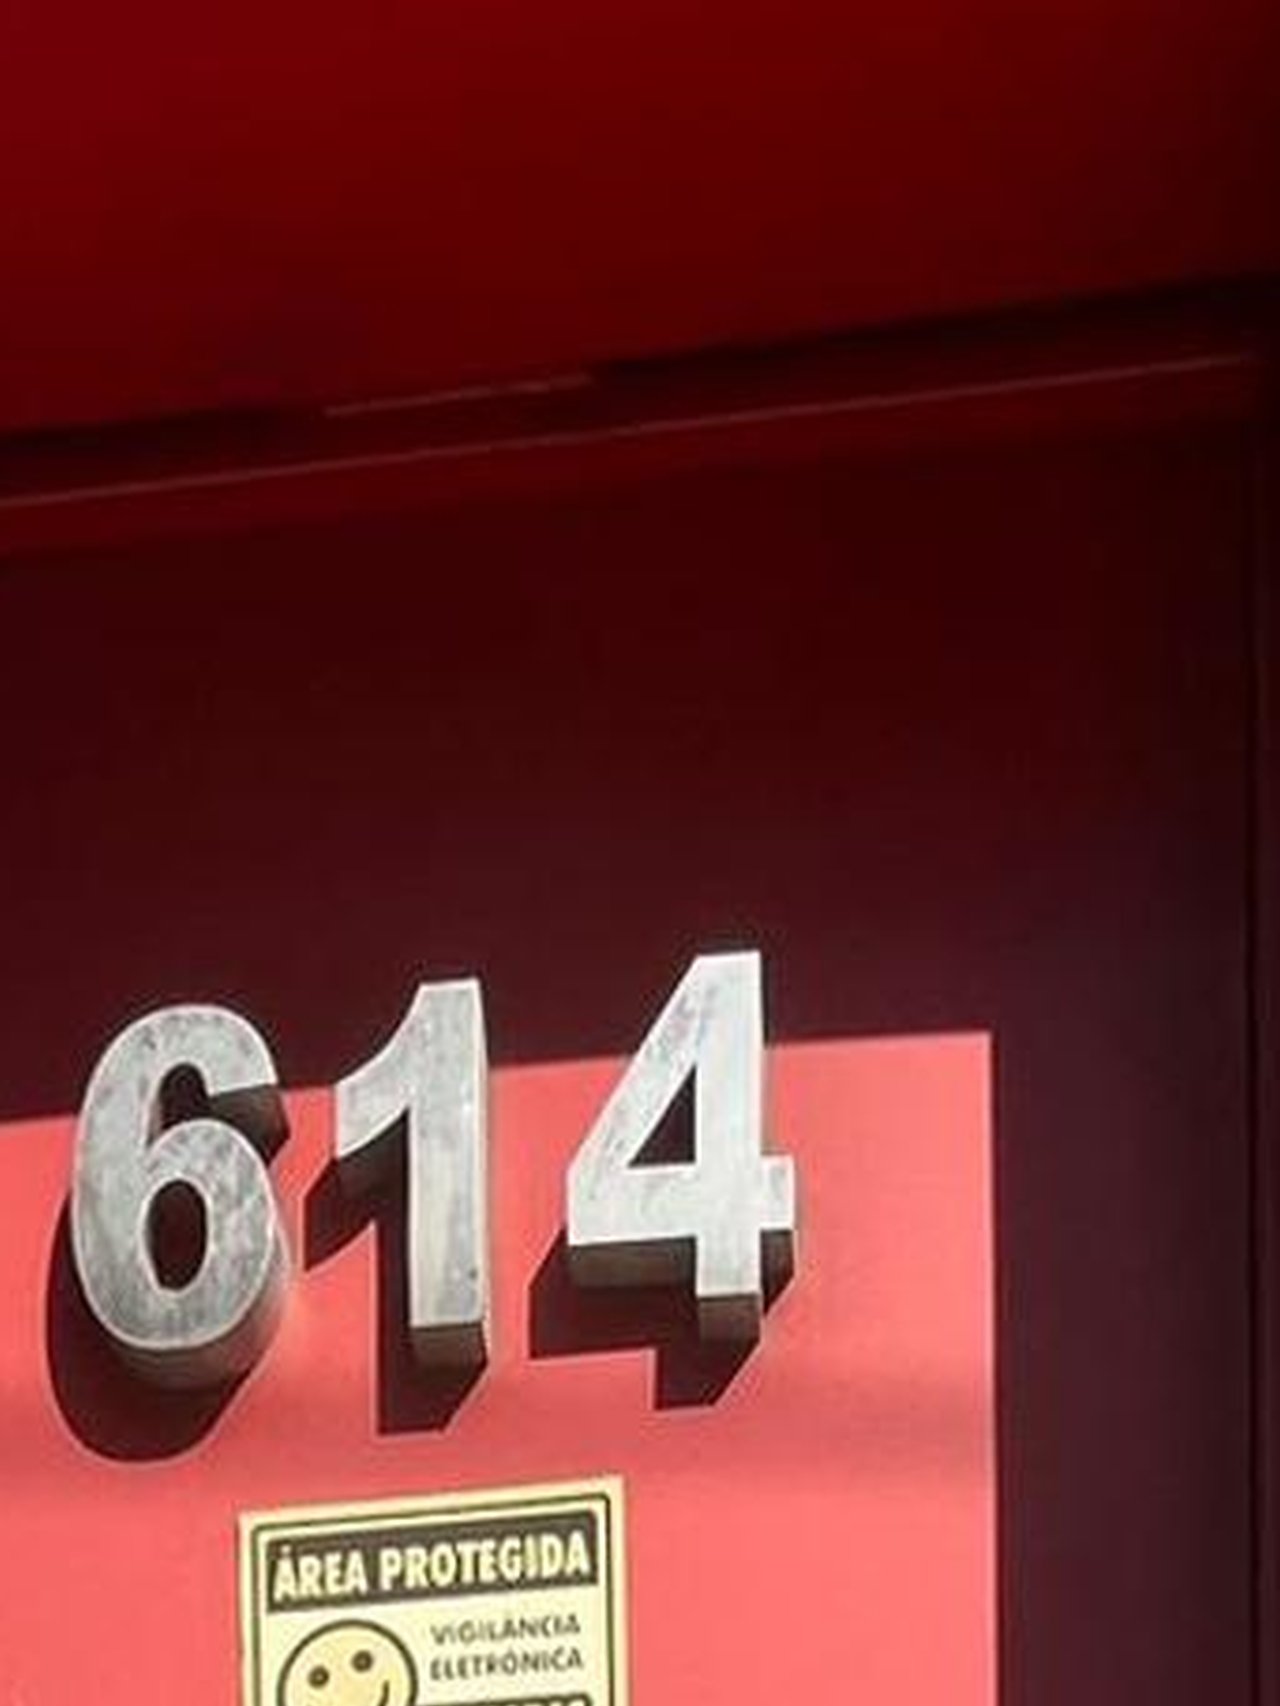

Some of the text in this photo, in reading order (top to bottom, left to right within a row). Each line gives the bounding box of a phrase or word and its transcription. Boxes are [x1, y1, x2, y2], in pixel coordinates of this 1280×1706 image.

[70, 950, 796, 1362] 614
[273, 1529, 590, 1603] ÁREA PROTEGIDA
